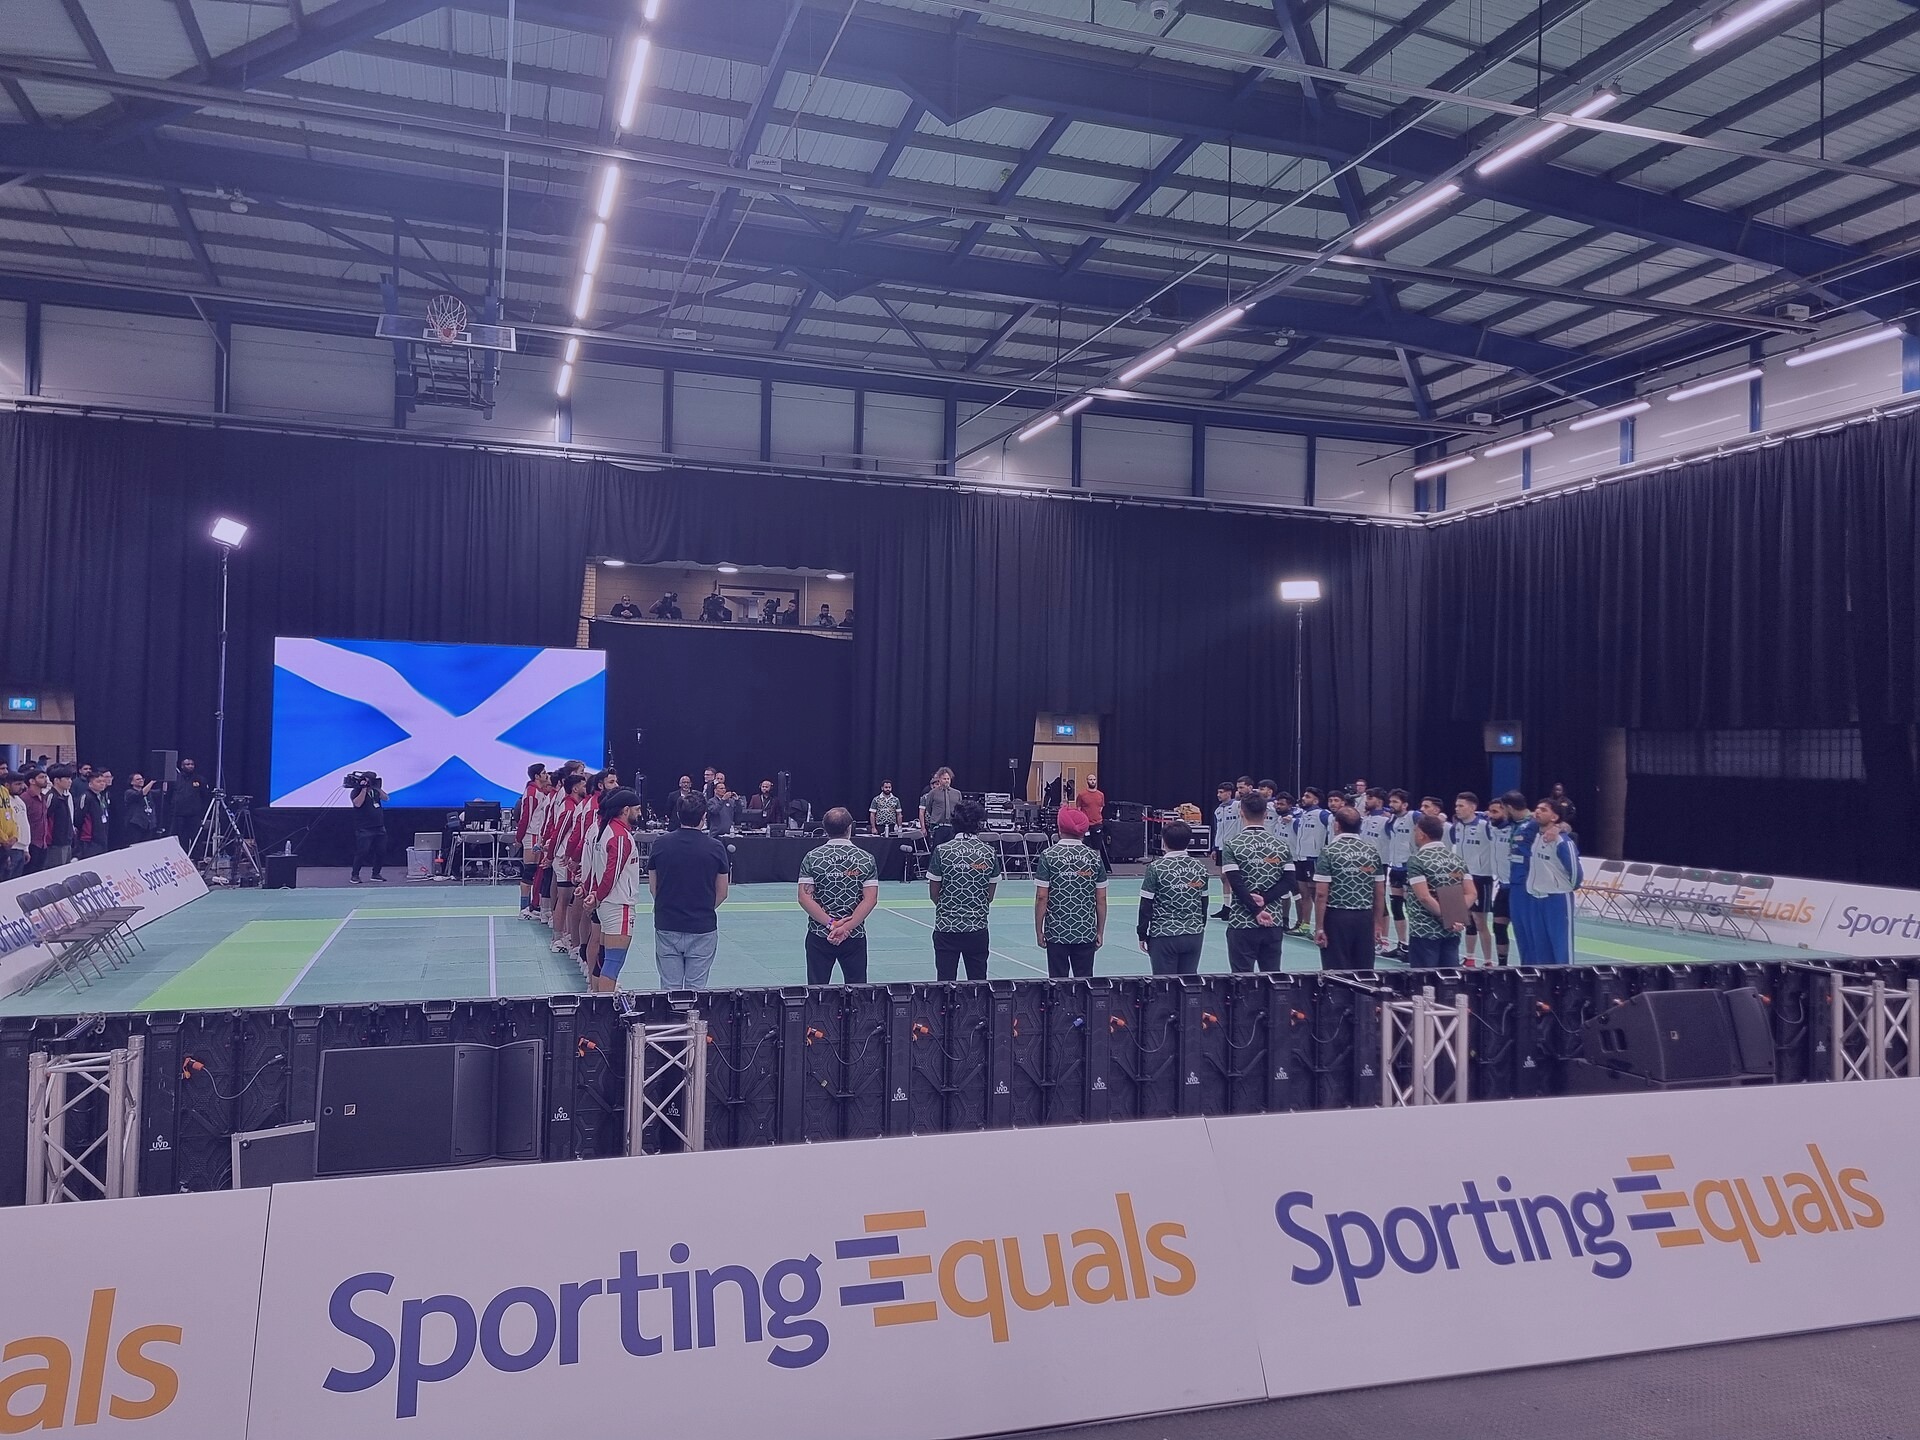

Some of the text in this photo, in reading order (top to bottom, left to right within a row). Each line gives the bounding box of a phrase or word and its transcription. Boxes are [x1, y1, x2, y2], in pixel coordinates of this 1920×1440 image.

[138, 863, 178, 895] Sporting
[152, 1141, 169, 1149] UVD
[554, 1112, 568, 1120] UVD
[1274, 1143, 1885, 1308] Sporting Equals
[322, 1192, 1198, 1419] Sporting Equals
[0, 1287, 183, 1435] als
